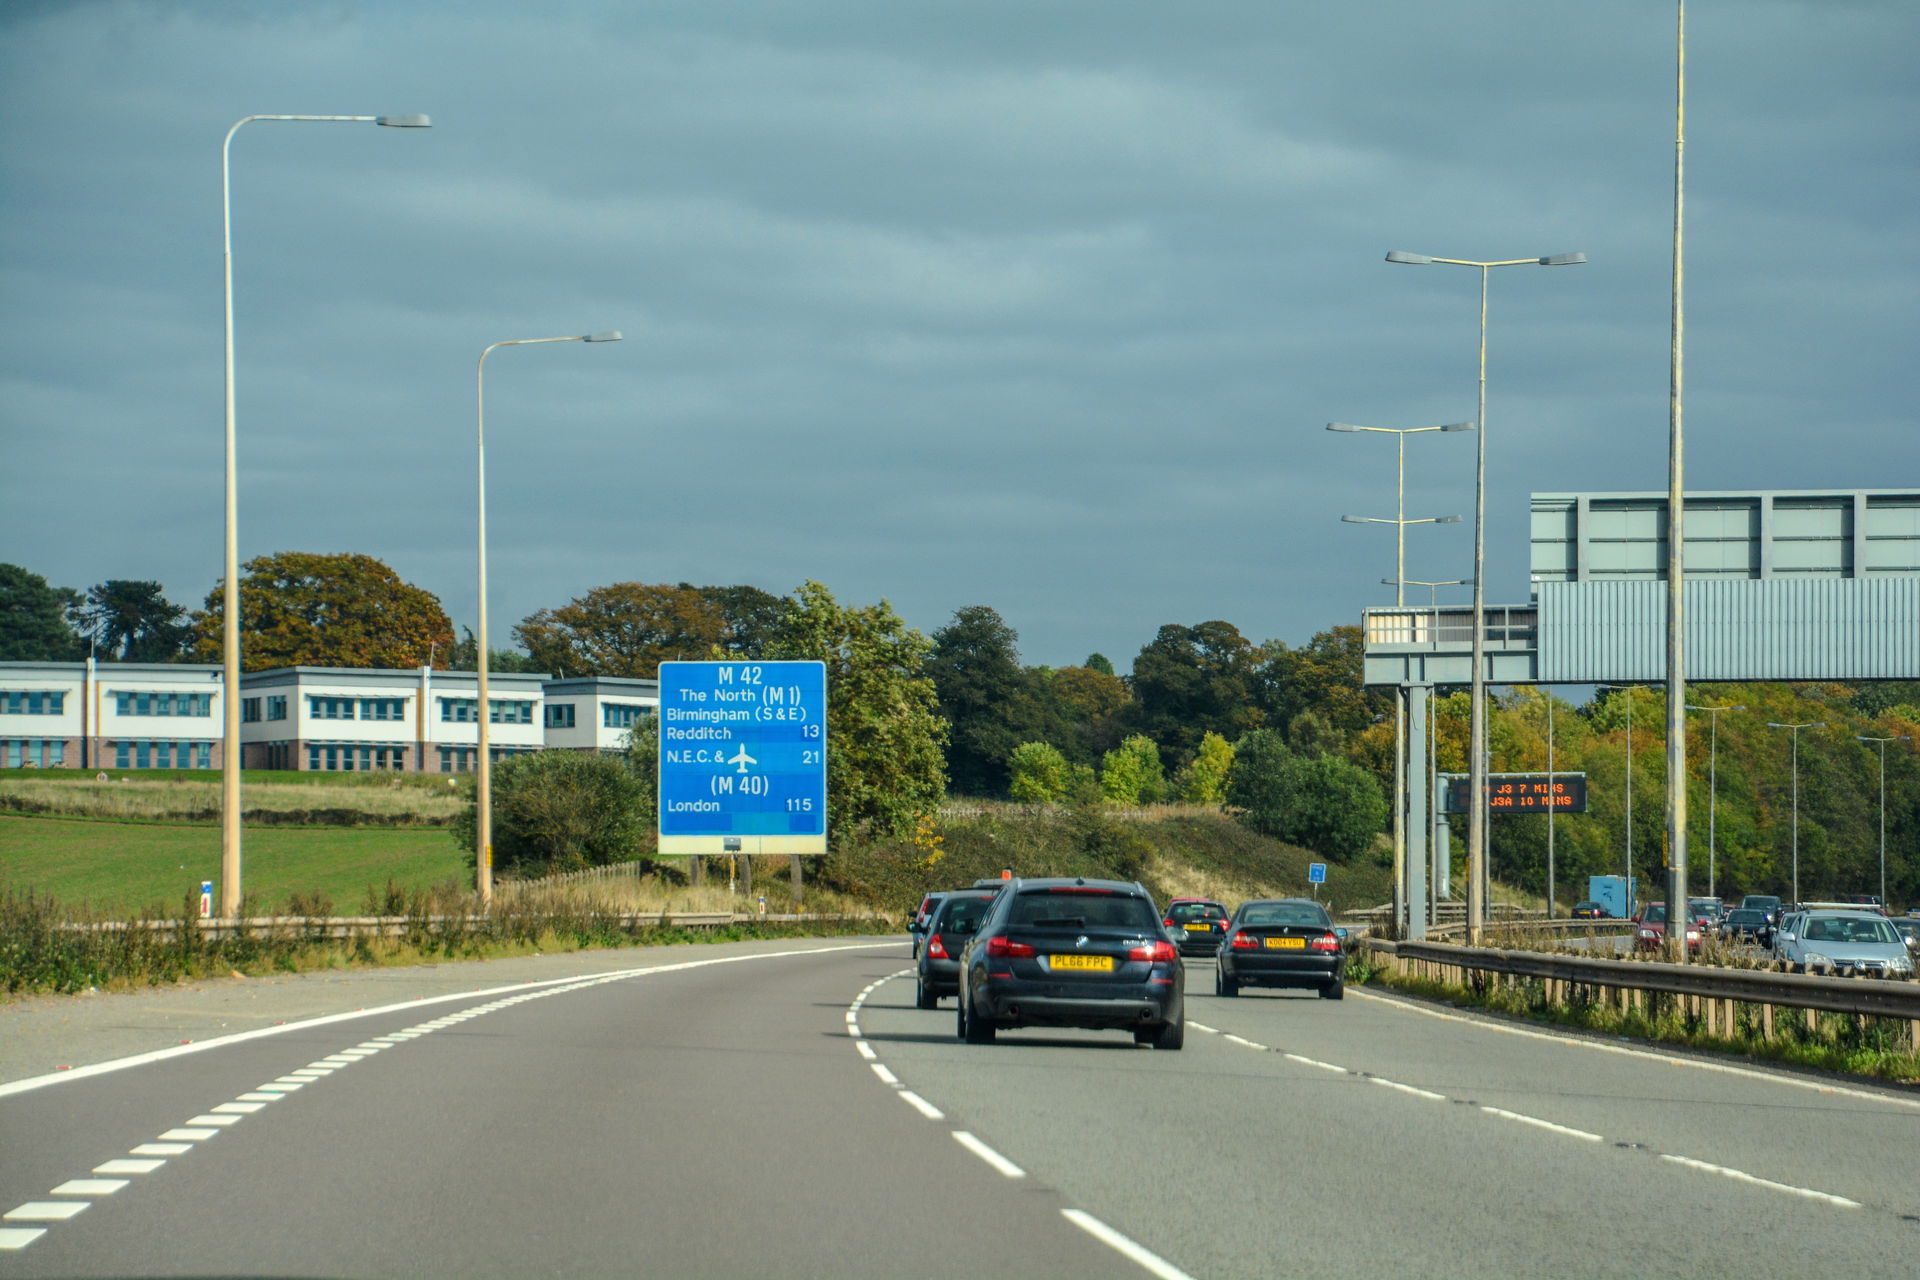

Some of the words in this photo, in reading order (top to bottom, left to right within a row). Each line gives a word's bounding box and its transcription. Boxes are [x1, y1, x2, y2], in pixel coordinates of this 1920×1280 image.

[719, 667, 732, 684] M
[741, 667, 762, 685] 42
[680, 689, 706, 701] The
[715, 689, 755, 701] North
[667, 708, 749, 723] Birmingham
[667, 728, 731, 739] Redditch
[802, 725, 819, 738] 13
[802, 751, 819, 764] 21
[1497, 784, 1512, 794] J3
[1520, 784, 1527, 793] 7
[668, 800, 719, 812] London
[786, 799, 811, 811] 115
[1490, 796, 1512, 806] J3A
[1520, 796, 1533, 806] 10
[1055, 956, 1083, 966] PL66
[1086, 957, 1107, 967] FPC
